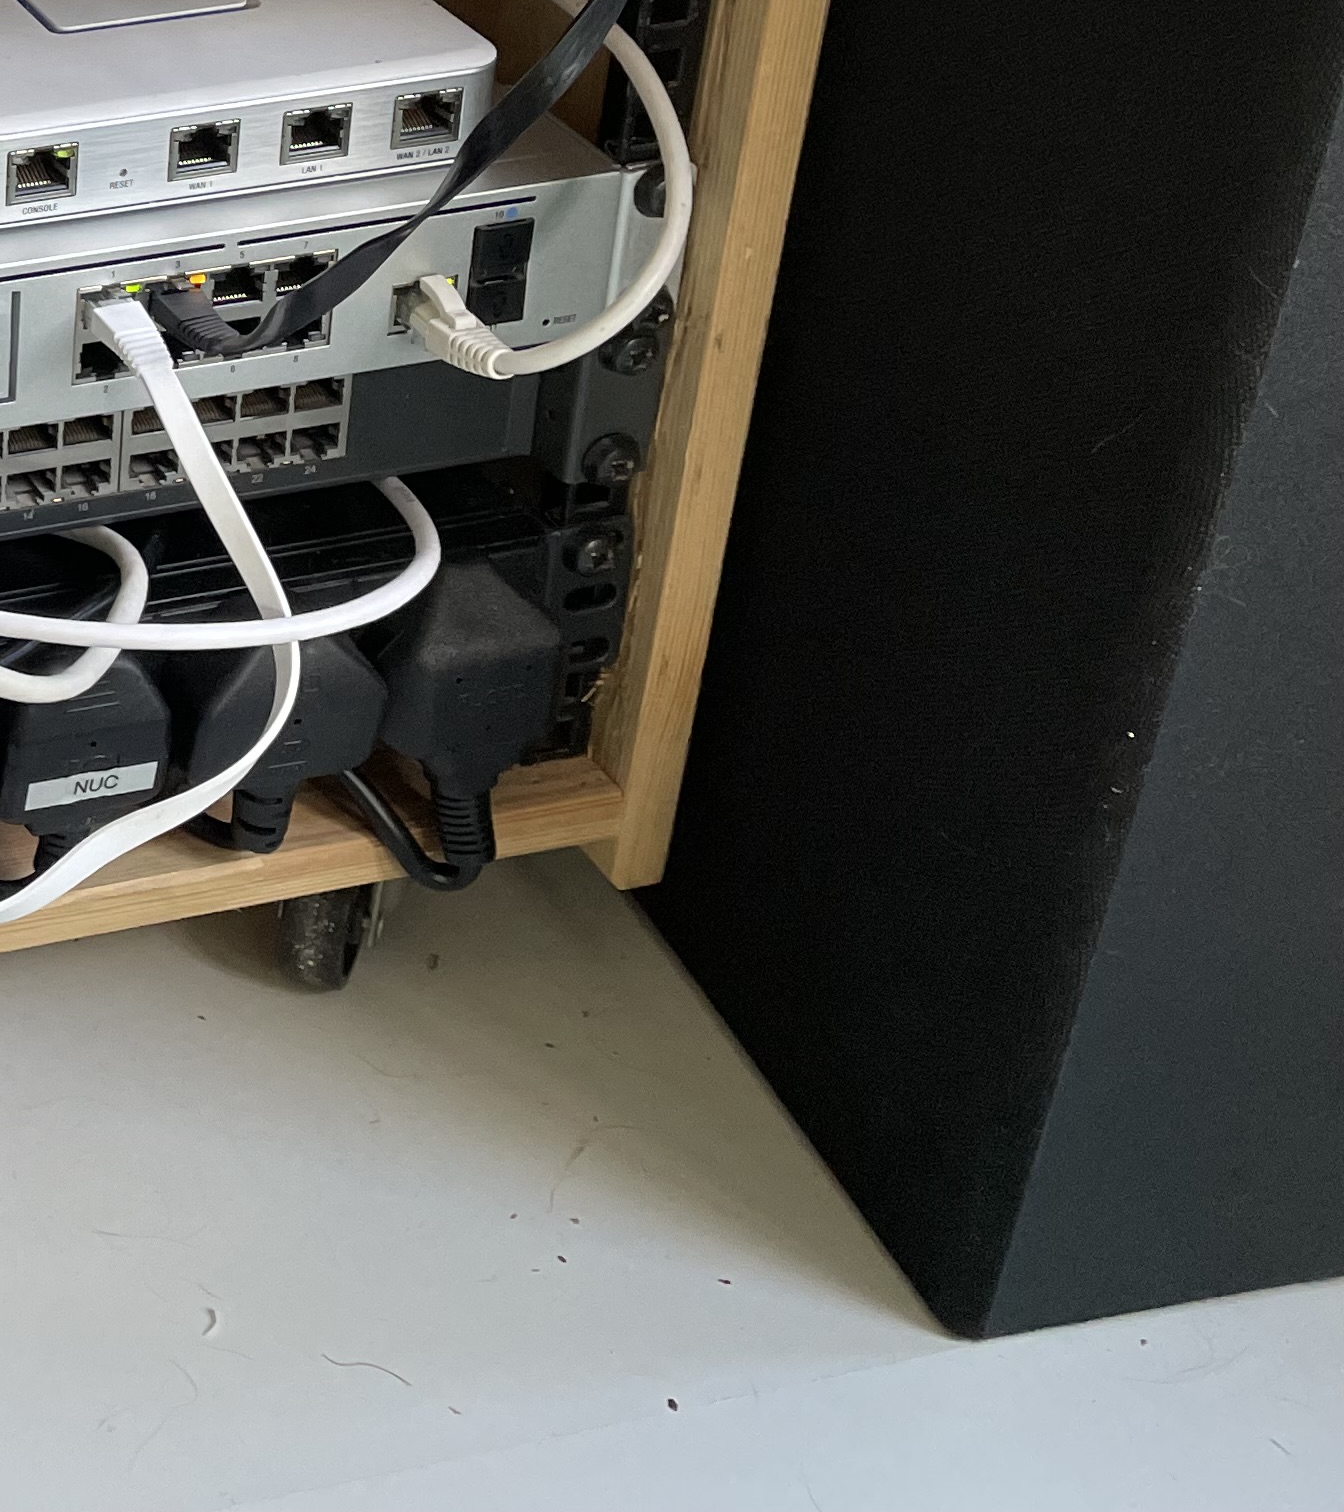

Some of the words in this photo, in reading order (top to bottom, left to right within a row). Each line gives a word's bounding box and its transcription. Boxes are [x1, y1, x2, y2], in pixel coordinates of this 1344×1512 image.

[396, 151, 414, 161] WAN
[415, 149, 421, 159] 2
[427, 147, 443, 157] LAN
[444, 145, 450, 155] 2
[301, 166, 317, 175] LAN
[109, 179, 134, 190] RESET
[188, 182, 207, 191] WAN
[21, 203, 59, 216] CONSOLE
[494, 210, 505, 219] 10
[175, 260, 181, 269] 3
[239, 250, 246, 260] 5
[304, 240, 310, 250] 7
[553, 313, 577, 325] RESET
[103, 384, 110, 394] 2
[293, 354, 299, 364] 8
[23, 510, 35, 521] 14
[251, 473, 263, 484] 22
[73, 774, 120, 796] NUC
